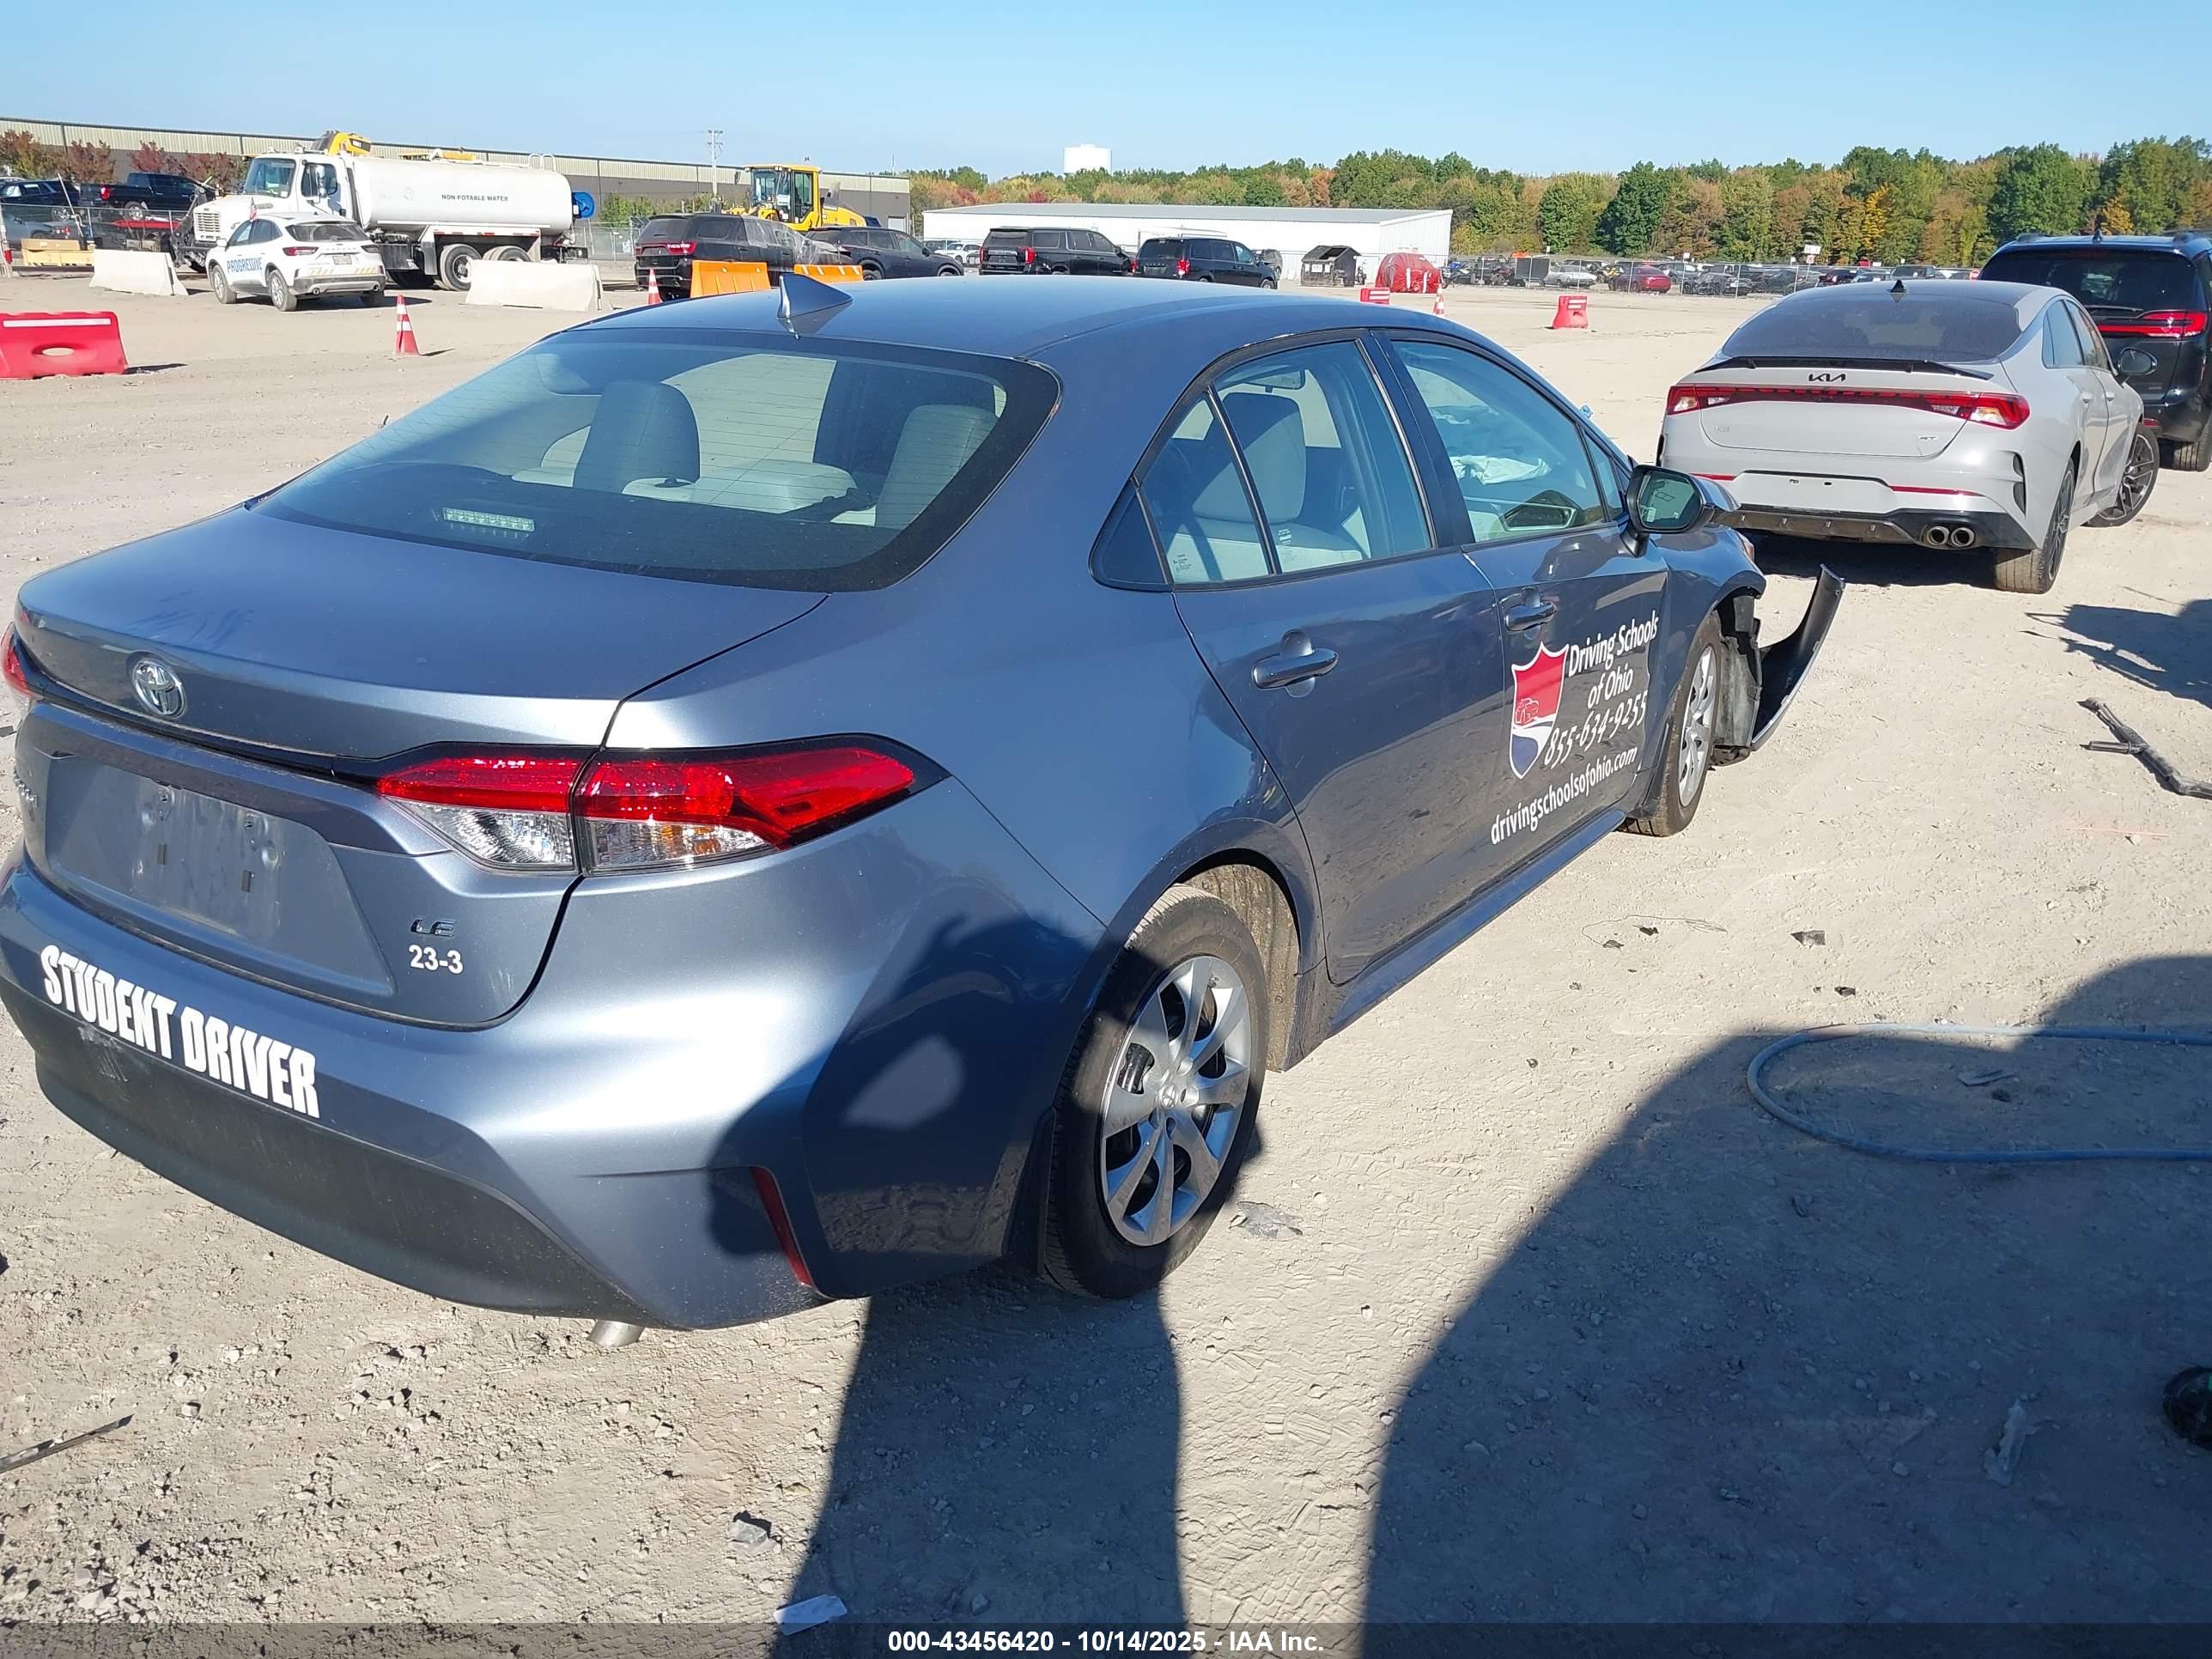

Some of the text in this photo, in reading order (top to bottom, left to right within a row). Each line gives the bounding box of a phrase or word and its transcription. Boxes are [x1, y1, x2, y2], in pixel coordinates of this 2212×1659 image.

[227, 257, 263, 273] PROGRESSIVE
[1808, 373, 1846, 383] KIA
[1568, 610, 1659, 677] Driving Schools
[1588, 663, 1633, 708] of Ohio
[1544, 690, 1648, 770] 855-634-9255
[1491, 746, 1638, 845] drivingschoolsofohio.com
[410, 918, 456, 938] LE
[409, 945, 464, 974] 23-3
[40, 945, 320, 1119] STUDENT DRIVER
